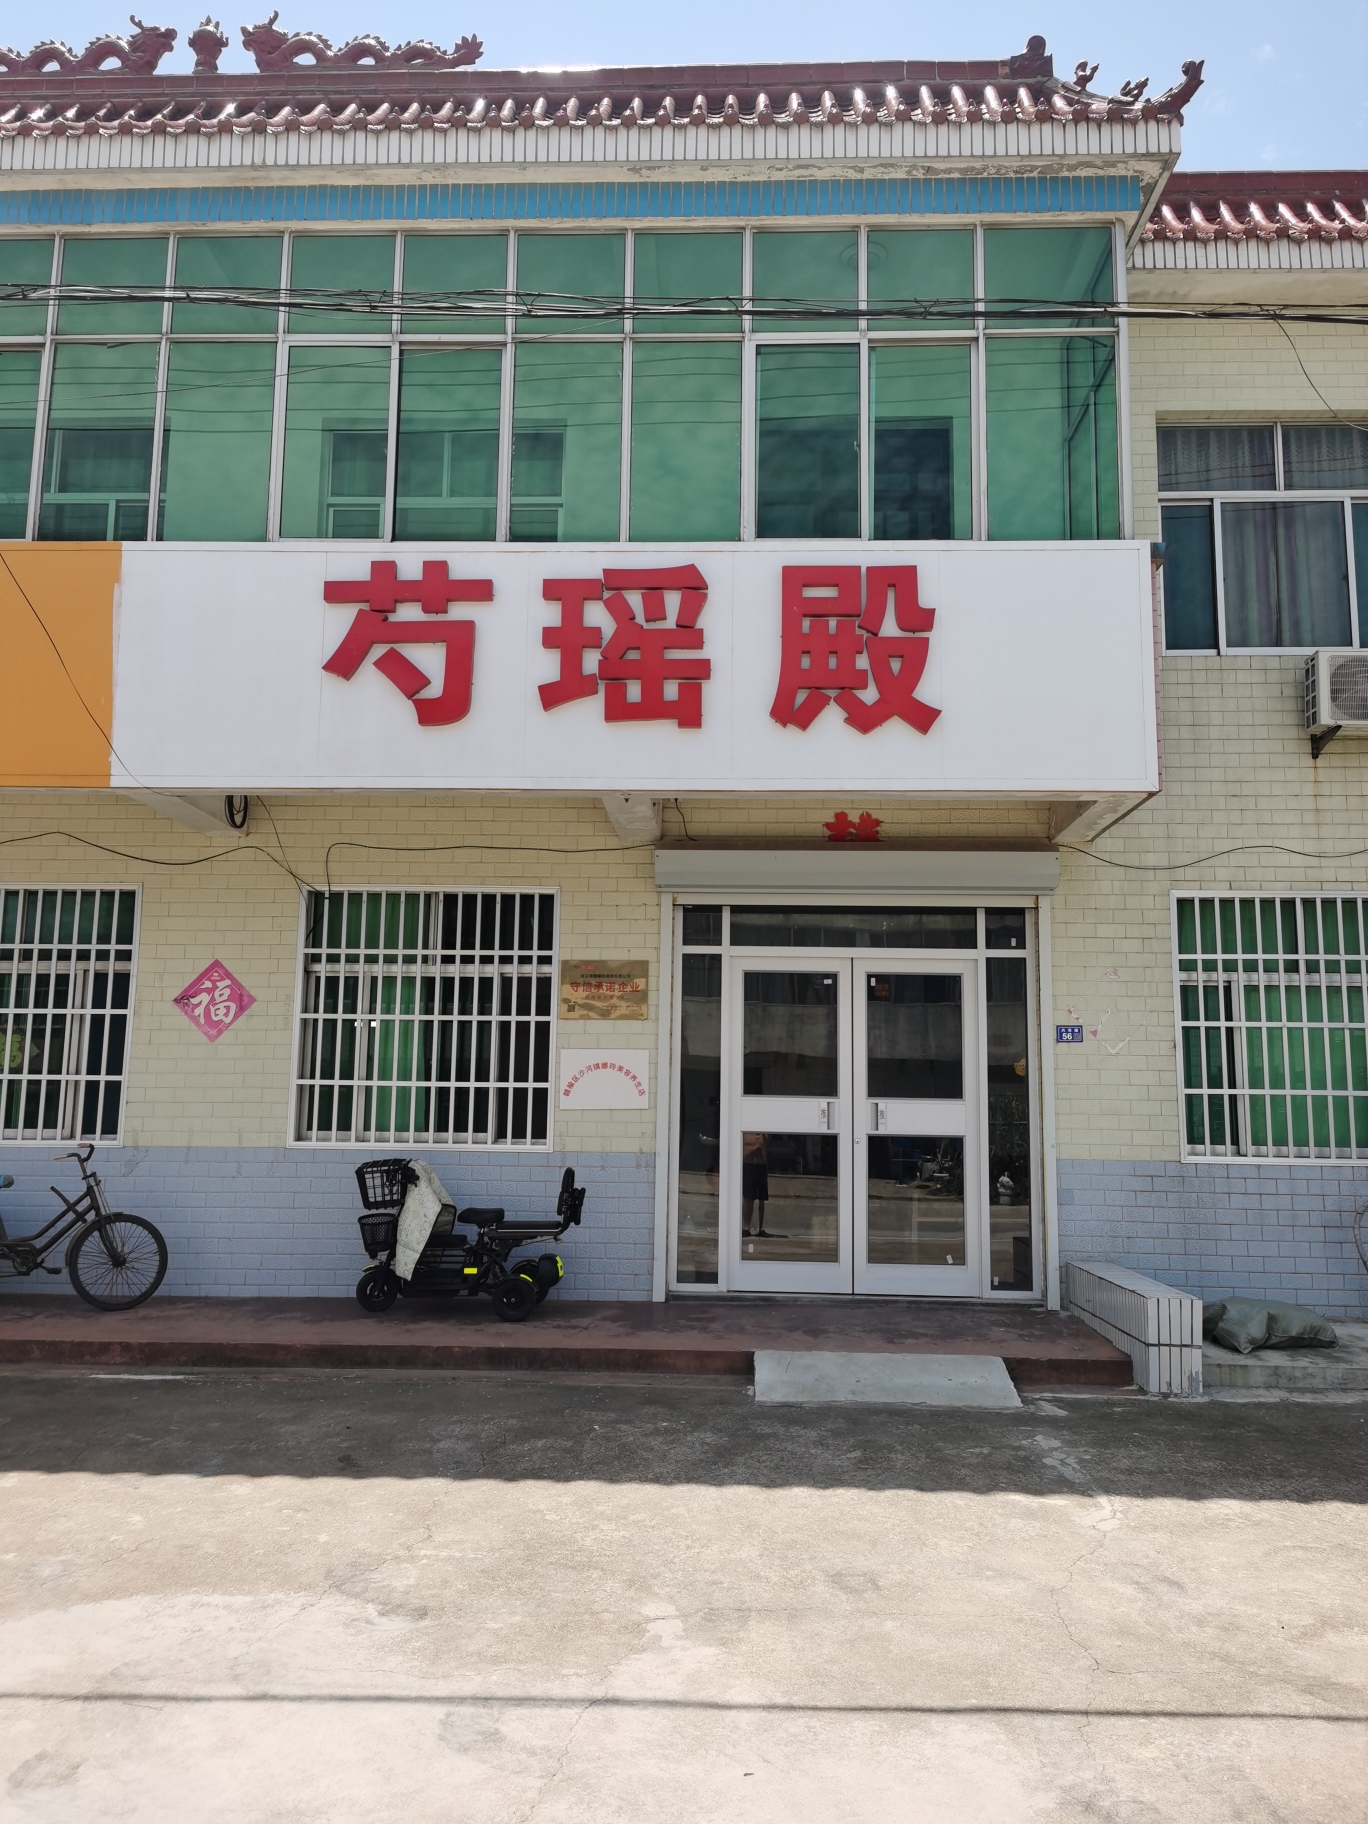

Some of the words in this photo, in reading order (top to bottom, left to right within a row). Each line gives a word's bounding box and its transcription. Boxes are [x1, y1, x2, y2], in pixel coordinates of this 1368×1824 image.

[322, 560, 943, 736] 芍瑶殿
[570, 981, 640, 993] 守信承诺企业
[189, 979, 237, 1025] 福
[1062, 1032, 1073, 1040] 56
